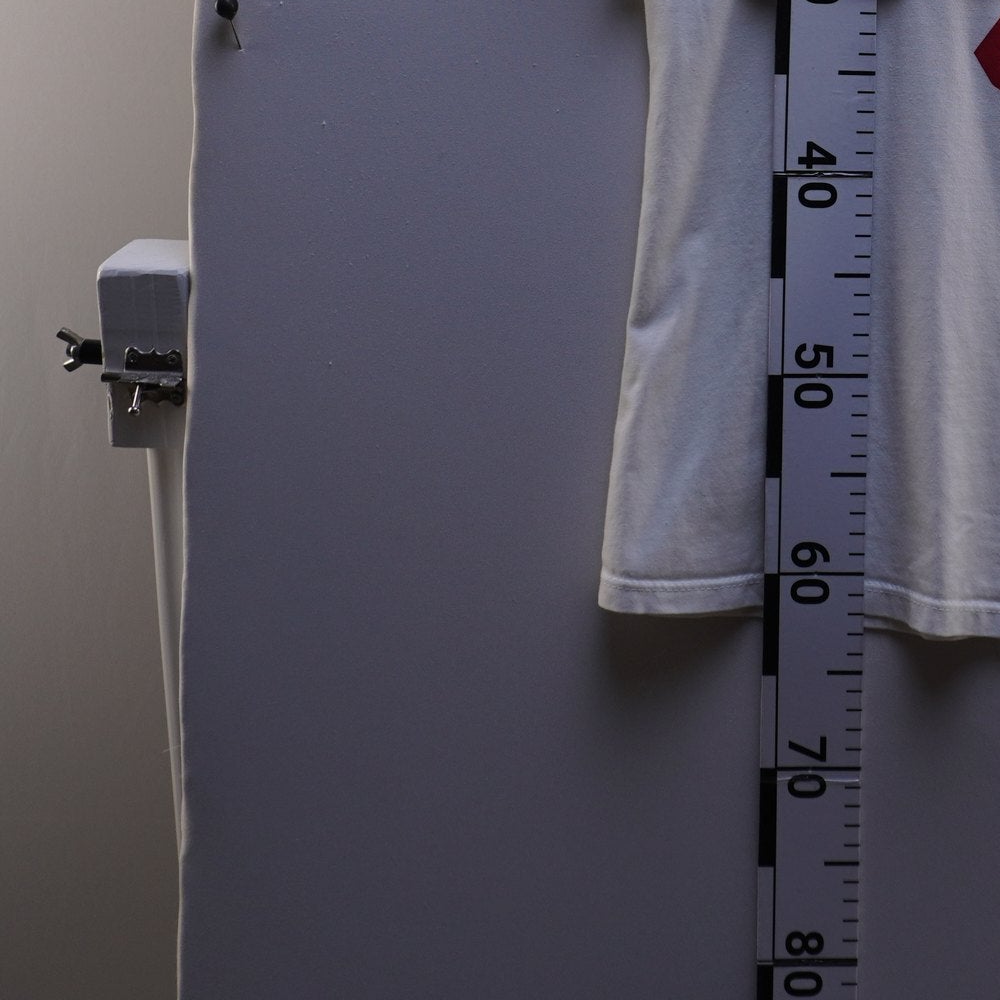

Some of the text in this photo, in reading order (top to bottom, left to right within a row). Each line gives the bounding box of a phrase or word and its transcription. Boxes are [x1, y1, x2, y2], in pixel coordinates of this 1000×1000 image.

[797, 140, 838, 209] 40
[793, 342, 834, 409] 50
[790, 541, 831, 605] 60
[787, 735, 827, 799] 70
[783, 930, 825, 998] 80
